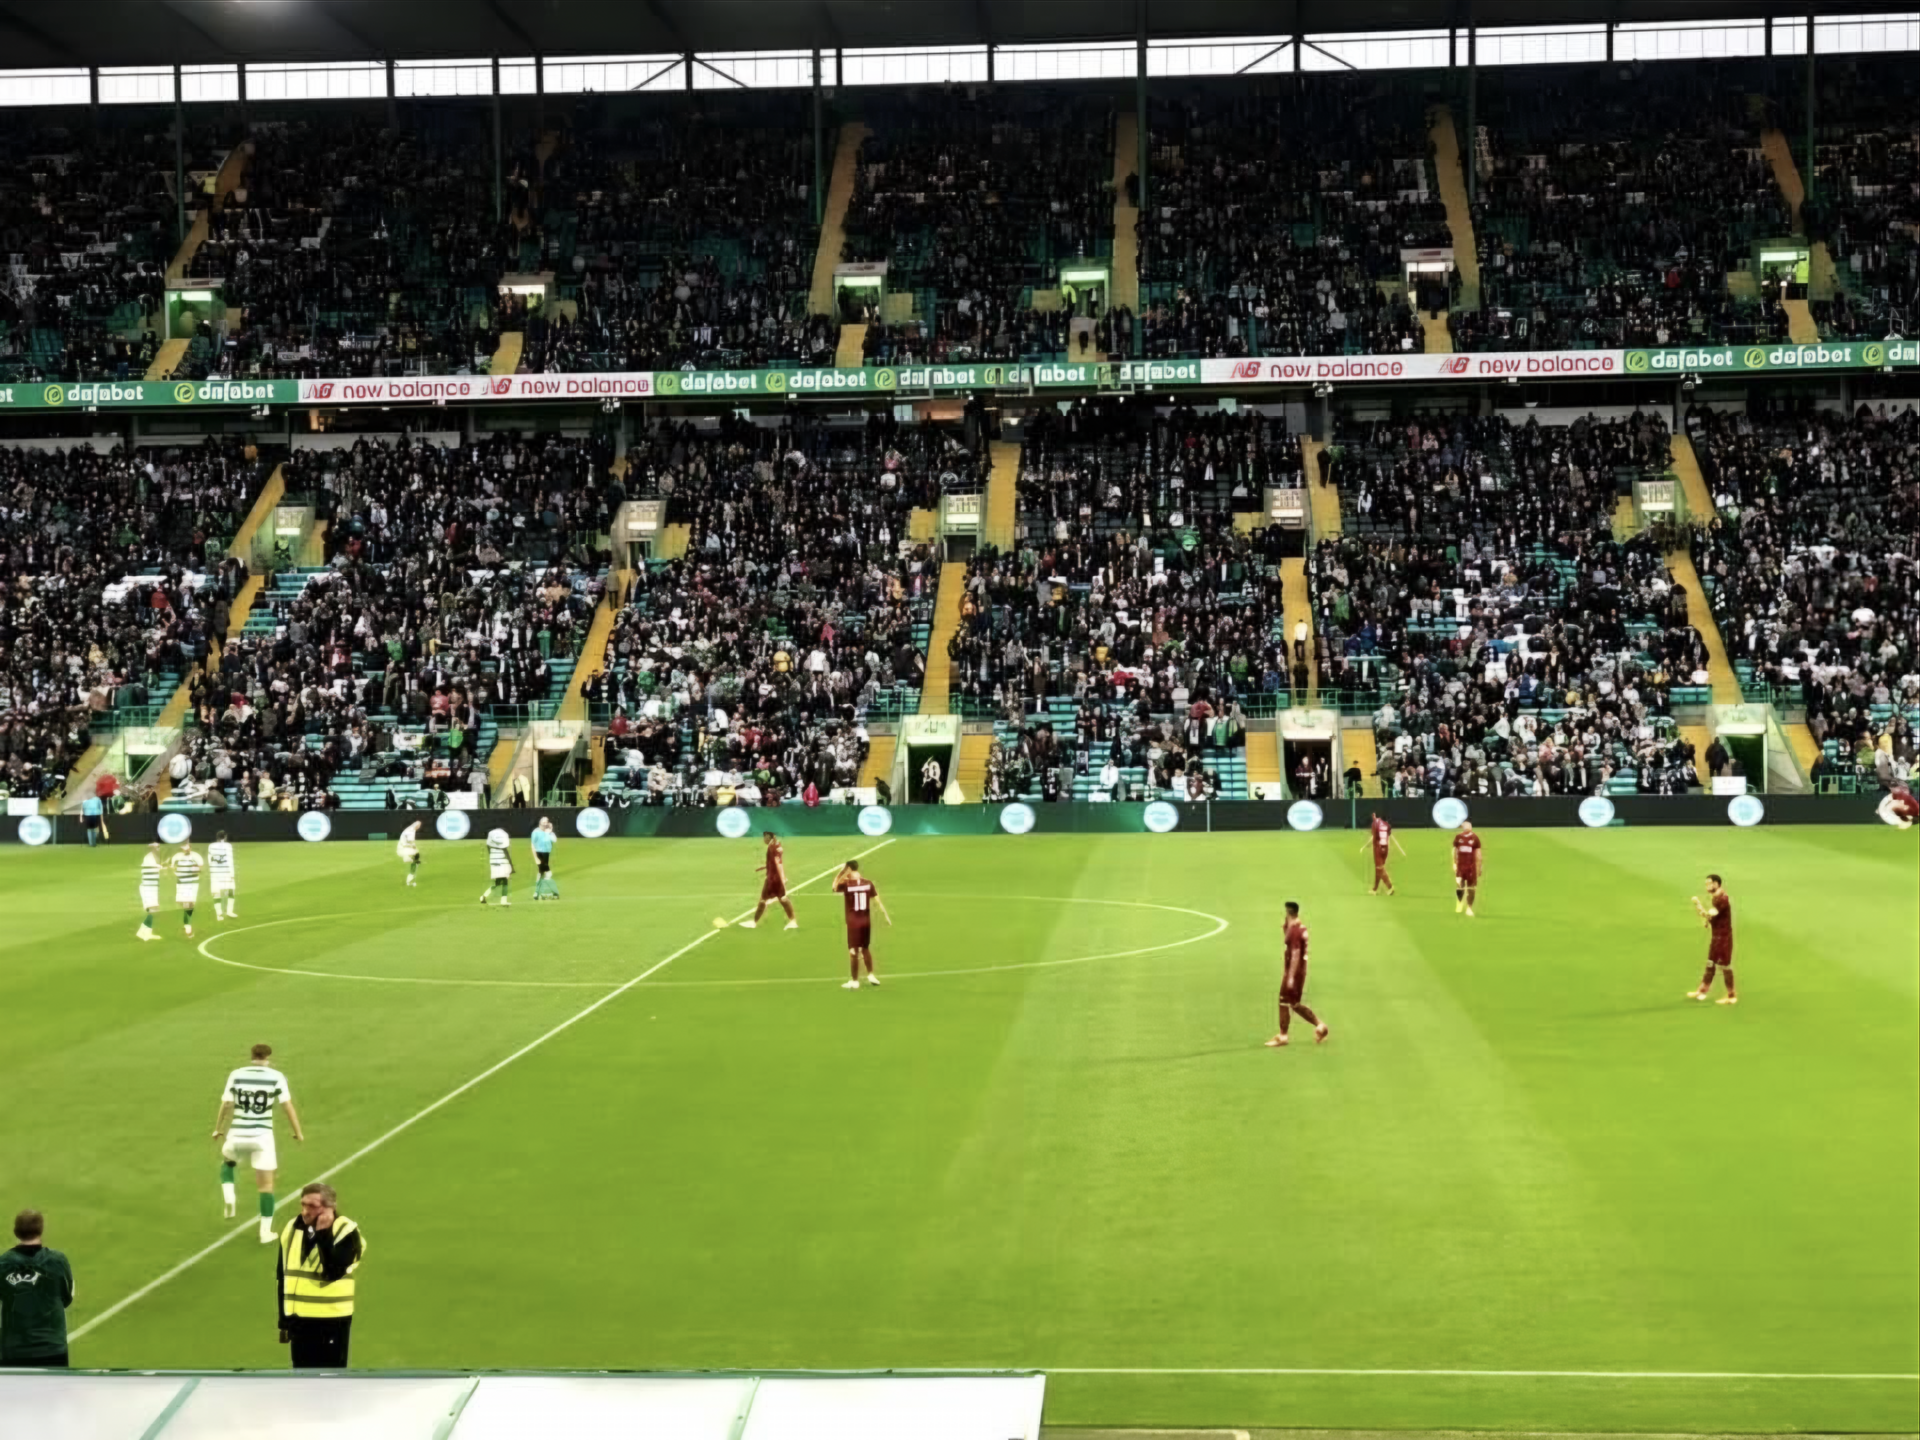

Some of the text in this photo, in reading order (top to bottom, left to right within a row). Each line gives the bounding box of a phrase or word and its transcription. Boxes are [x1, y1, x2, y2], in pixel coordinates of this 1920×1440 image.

[1479, 359, 1521, 374] new
[1527, 356, 1614, 373] balance
[1651, 349, 1733, 370] dafabet
[1769, 345, 1852, 366] dafabet
[1271, 364, 1311, 378] new
[1317, 358, 1403, 377] balance
[343, 384, 383, 399] new
[389, 381, 470, 397] balance
[521, 380, 561, 395] new
[566, 377, 649, 394] balance
[681, 373, 757, 393] dafabet
[790, 371, 866, 391] dafabet
[68, 384, 143, 404] dafabet
[199, 382, 274, 402] dafabet
[238, 1088, 268, 1115] 49
